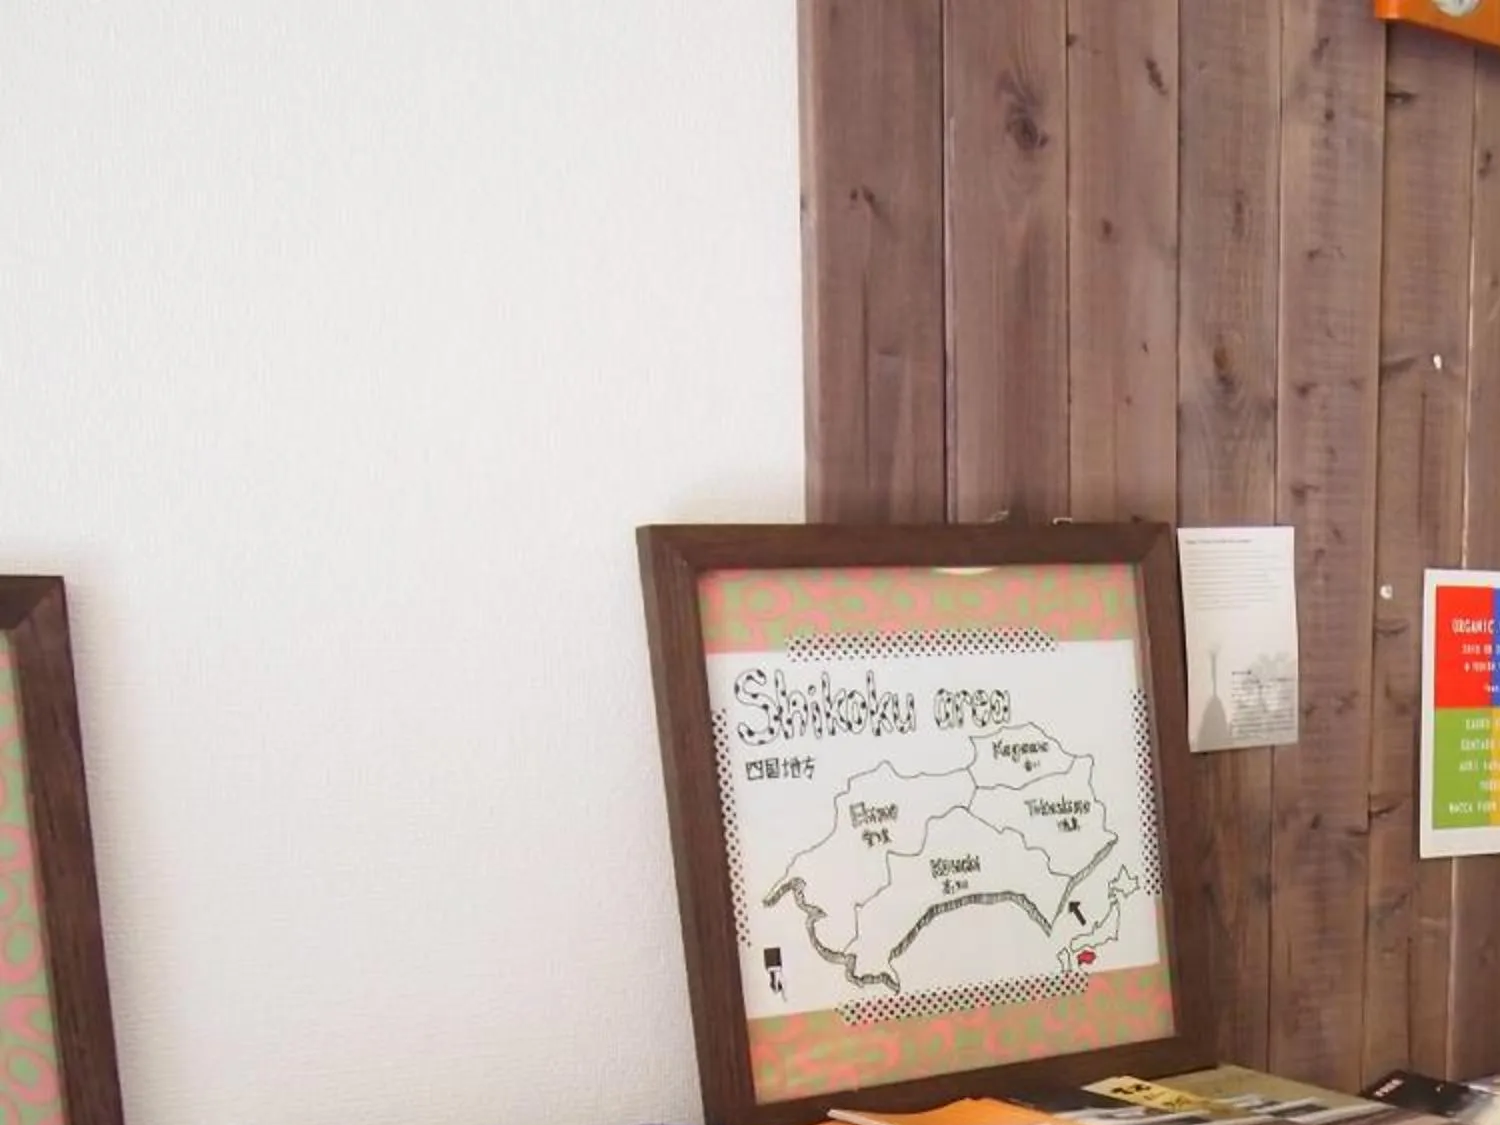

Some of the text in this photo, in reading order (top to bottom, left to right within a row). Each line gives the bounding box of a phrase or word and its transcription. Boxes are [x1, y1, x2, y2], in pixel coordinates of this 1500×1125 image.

[1452, 618, 1495, 635] ORGANIC
[734, 666, 1012, 746] Shikoku area
[744, 757, 816, 782] 四国地方
